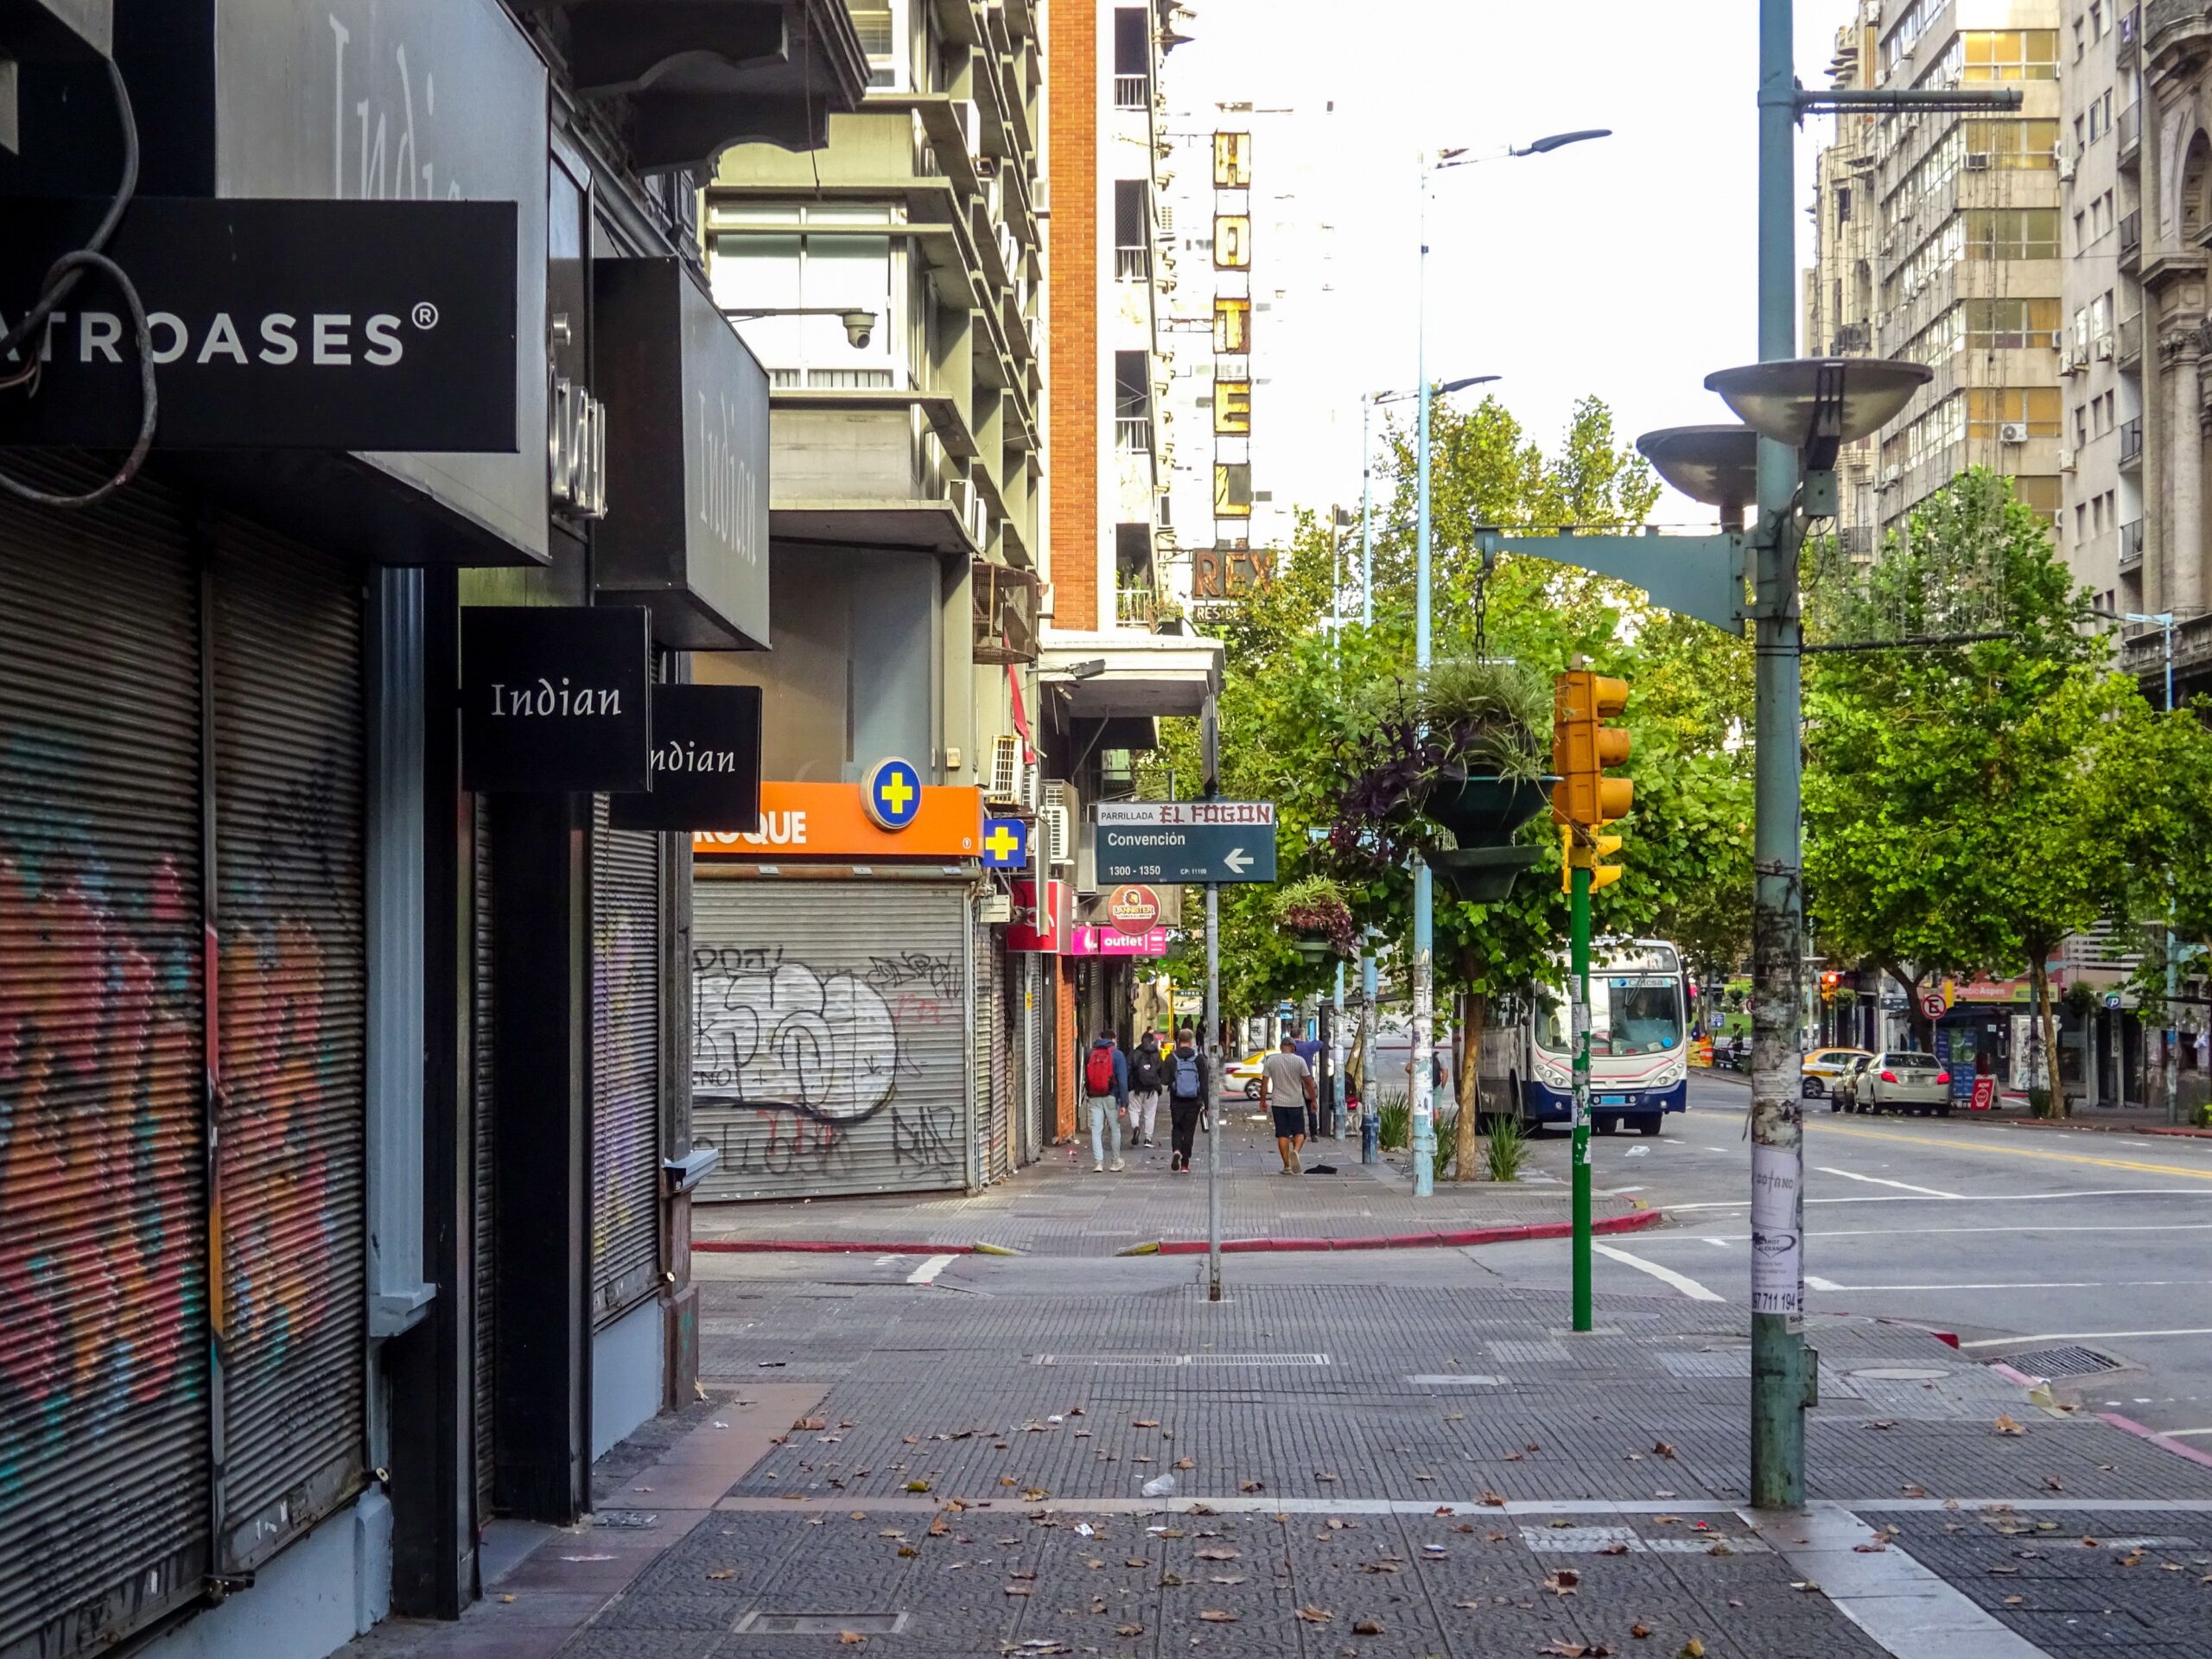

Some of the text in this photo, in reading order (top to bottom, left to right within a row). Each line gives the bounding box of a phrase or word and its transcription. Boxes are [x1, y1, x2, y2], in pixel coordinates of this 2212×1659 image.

[1213, 132, 1251, 517] HOTEL
[698, 391, 757, 567] Indian
[1195, 551, 1273, 596] REX
[491, 677, 621, 716] Indian
[651, 741, 735, 773] ndian
[1101, 811, 1154, 820] PARRILLADA
[1160, 804, 1185, 824] EL
[1108, 831, 1185, 847] Convención
[1109, 866, 1131, 876] 1300
[1139, 865, 1160, 875] 1350
[1104, 935, 1143, 946] outlet
[1764, 1293, 1777, 1310] 711
[1782, 1293, 1796, 1310] 194
